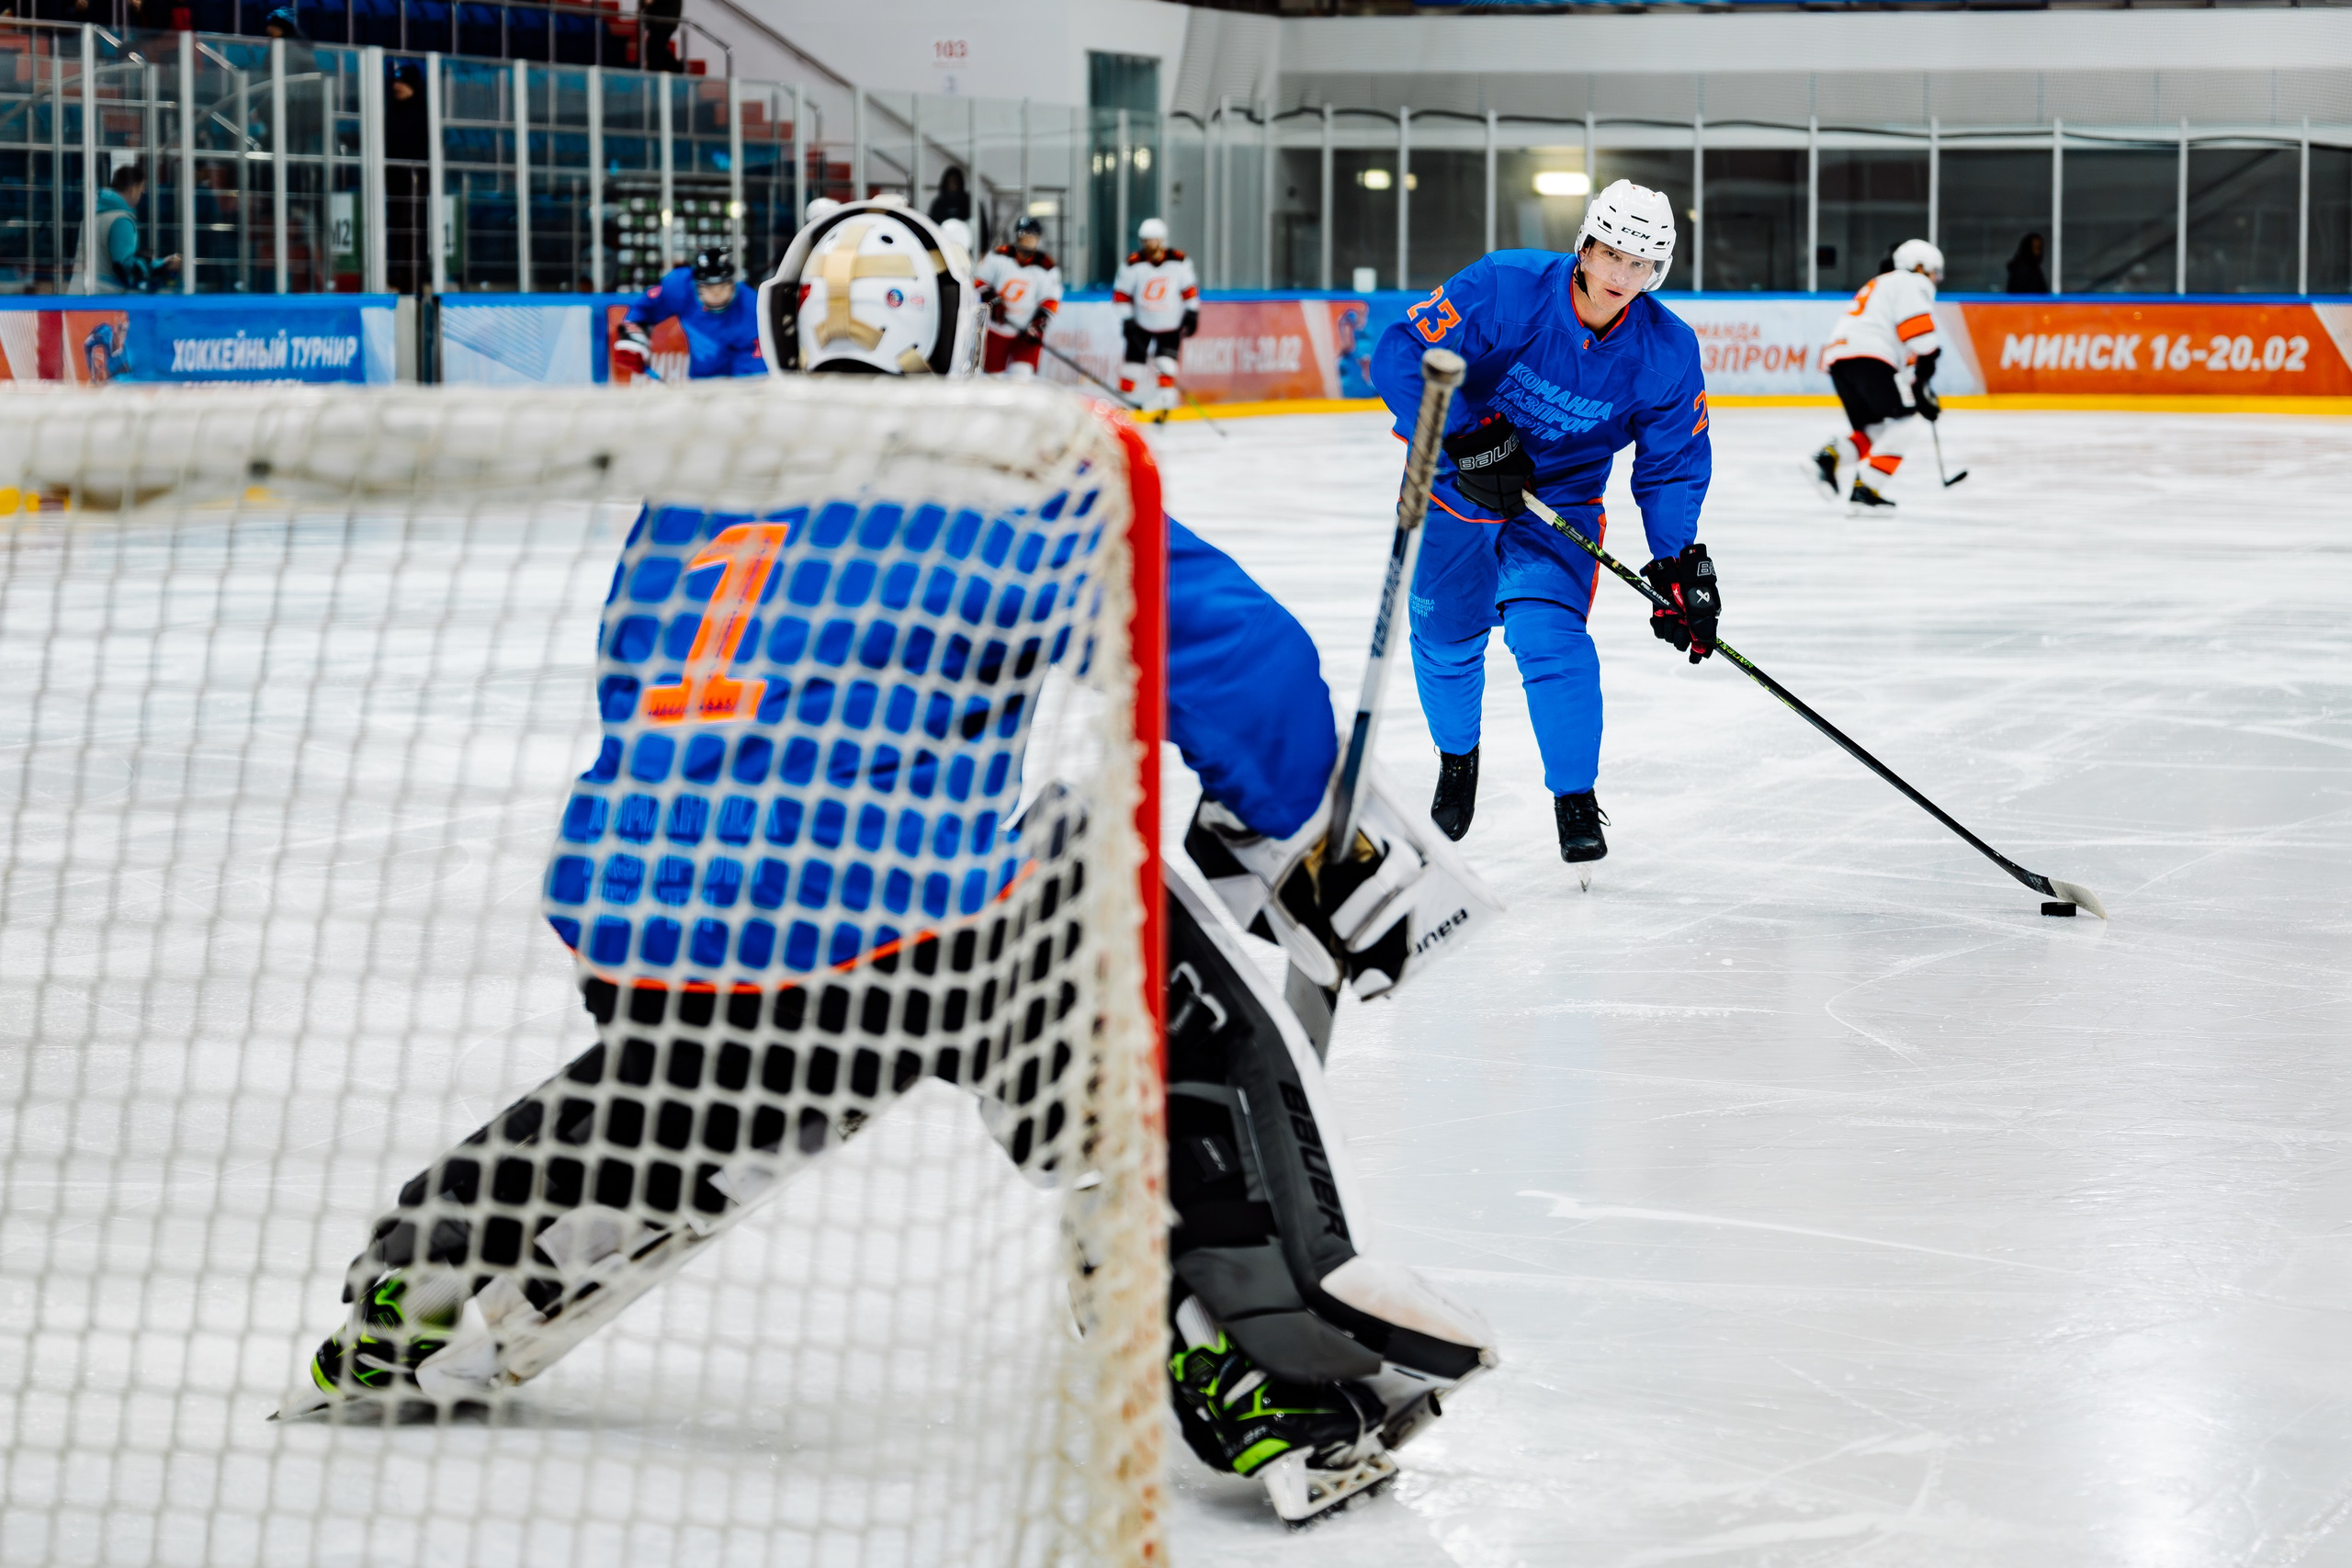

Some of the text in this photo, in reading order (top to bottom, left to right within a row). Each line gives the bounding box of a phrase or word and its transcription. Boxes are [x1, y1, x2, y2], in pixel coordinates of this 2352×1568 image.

[1621, 226, 1651, 240] CCM
[172, 329, 358, 372] ХОККЕЙНЫЙ ТУРНИР
[2000, 333, 2310, 372] МИНСК 16-20.02
[1496, 378, 1600, 433] ГАЗПРОМ
[1507, 361, 1613, 421] КОМАНДА
[1487, 395, 1566, 441] НЕФТИ
[639, 522, 788, 727] 1
